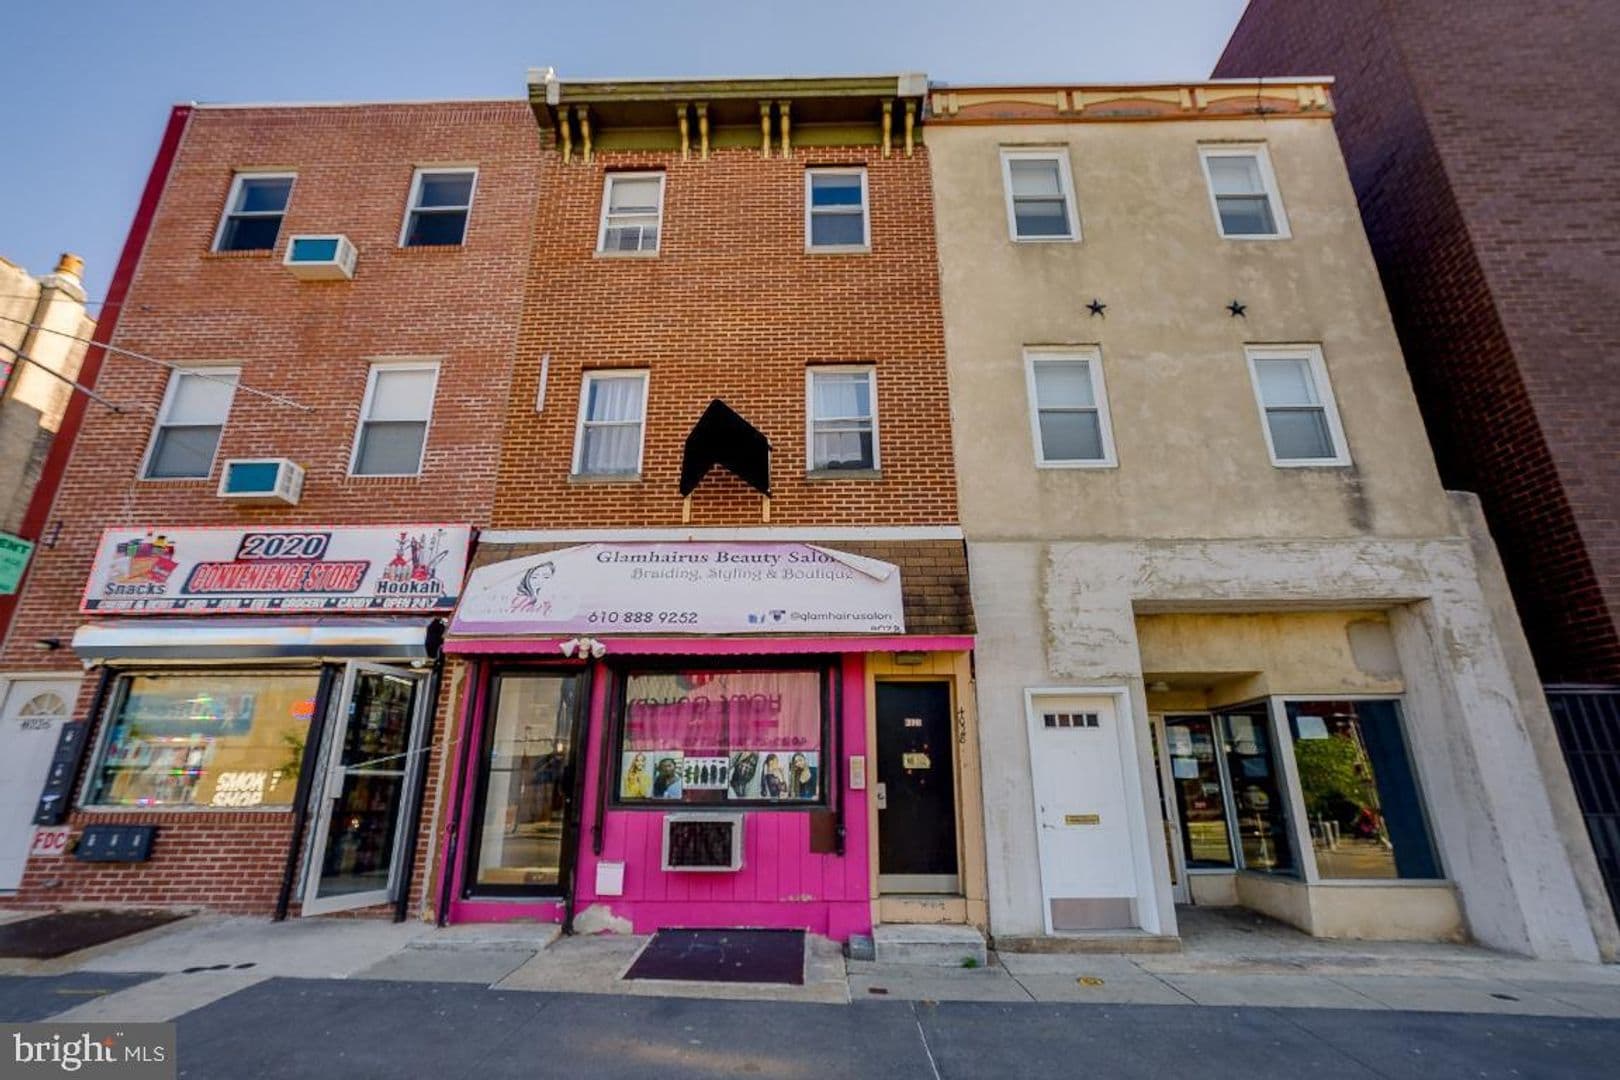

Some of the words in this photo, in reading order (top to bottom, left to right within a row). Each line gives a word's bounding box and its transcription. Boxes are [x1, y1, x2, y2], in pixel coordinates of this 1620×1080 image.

[244, 536, 325, 558] 2020
[597, 551, 709, 563] Glamhairus
[715, 551, 781, 567] Beauty
[189, 563, 308, 591] CONVENIENCE
[307, 563, 364, 590] STORE
[707, 568, 763, 582] Styling
[766, 569, 777, 579] &
[783, 568, 854, 580] Boutique
[105, 582, 166, 595] Snacks
[377, 580, 440, 593] Hookah
[588, 611, 619, 624] 610
[623, 611, 653, 624] 888
[658, 611, 698, 624] 9252
[32, 831, 66, 849] FDC
